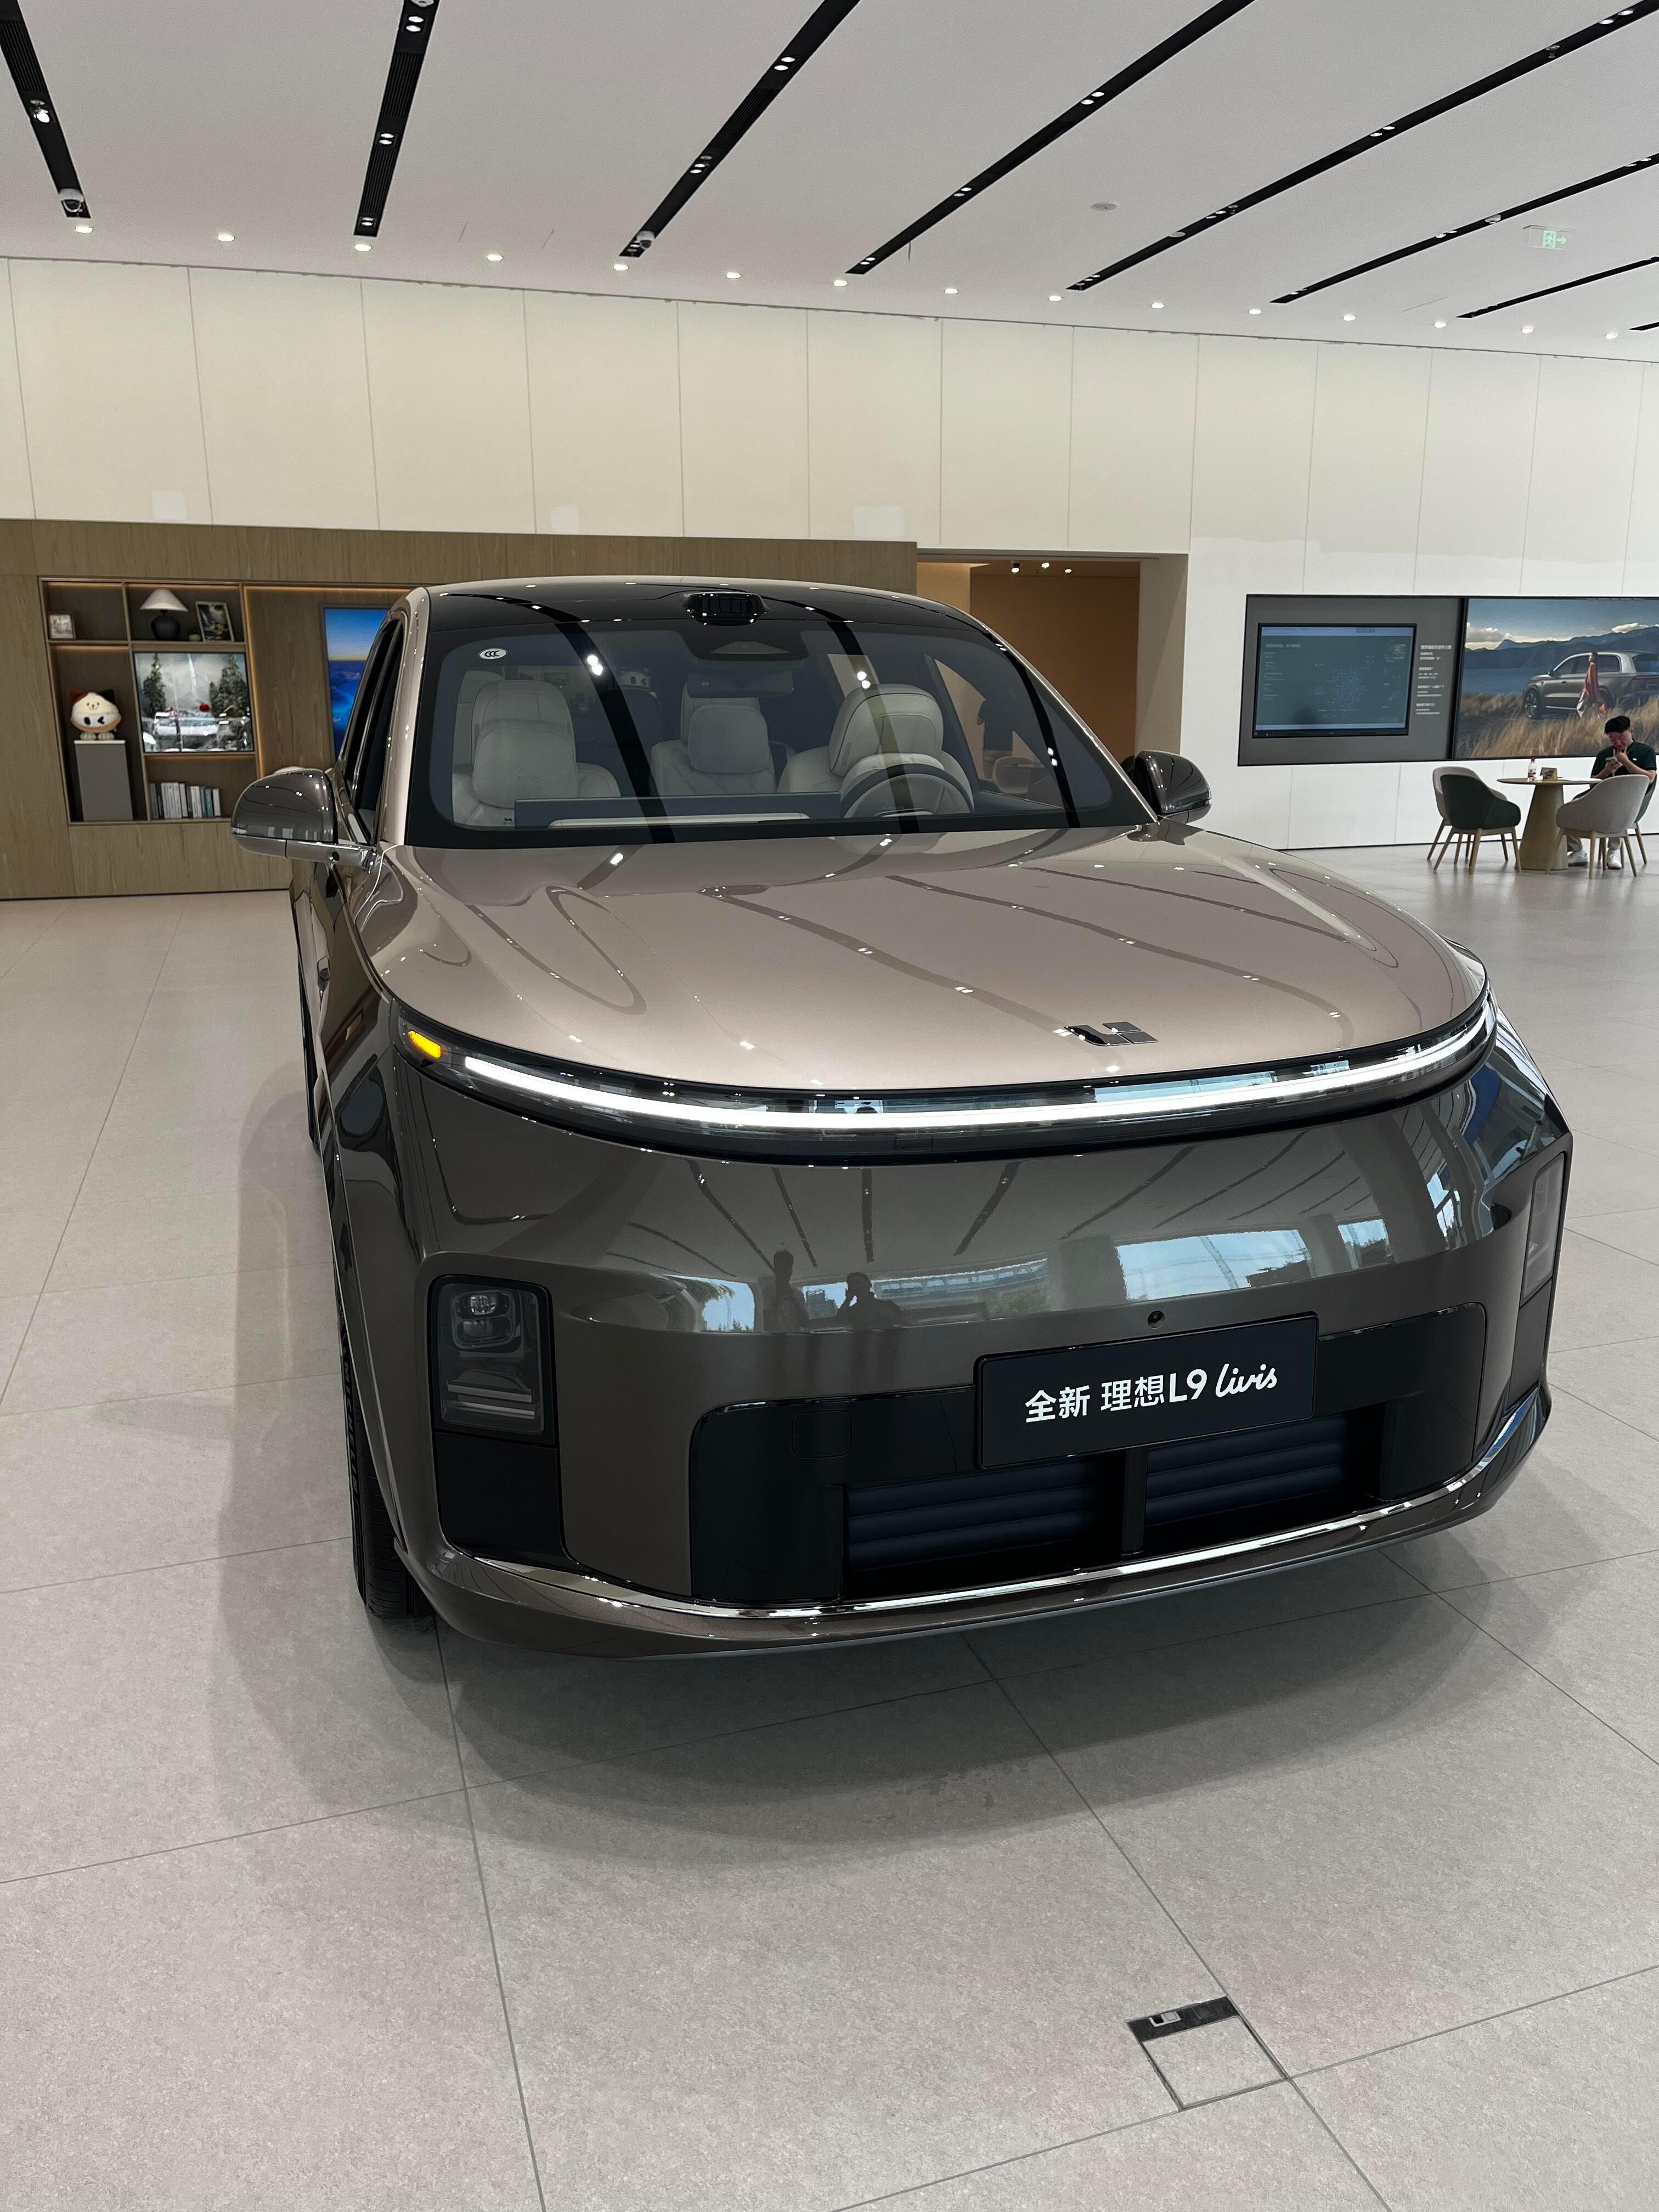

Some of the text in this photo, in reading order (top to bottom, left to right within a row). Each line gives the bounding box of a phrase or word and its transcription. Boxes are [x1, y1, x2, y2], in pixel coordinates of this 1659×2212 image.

[344, 1361, 358, 1493] MICHELIN
[1025, 1385, 1091, 1423] 全新
[1215, 1363, 1277, 1397] livis
